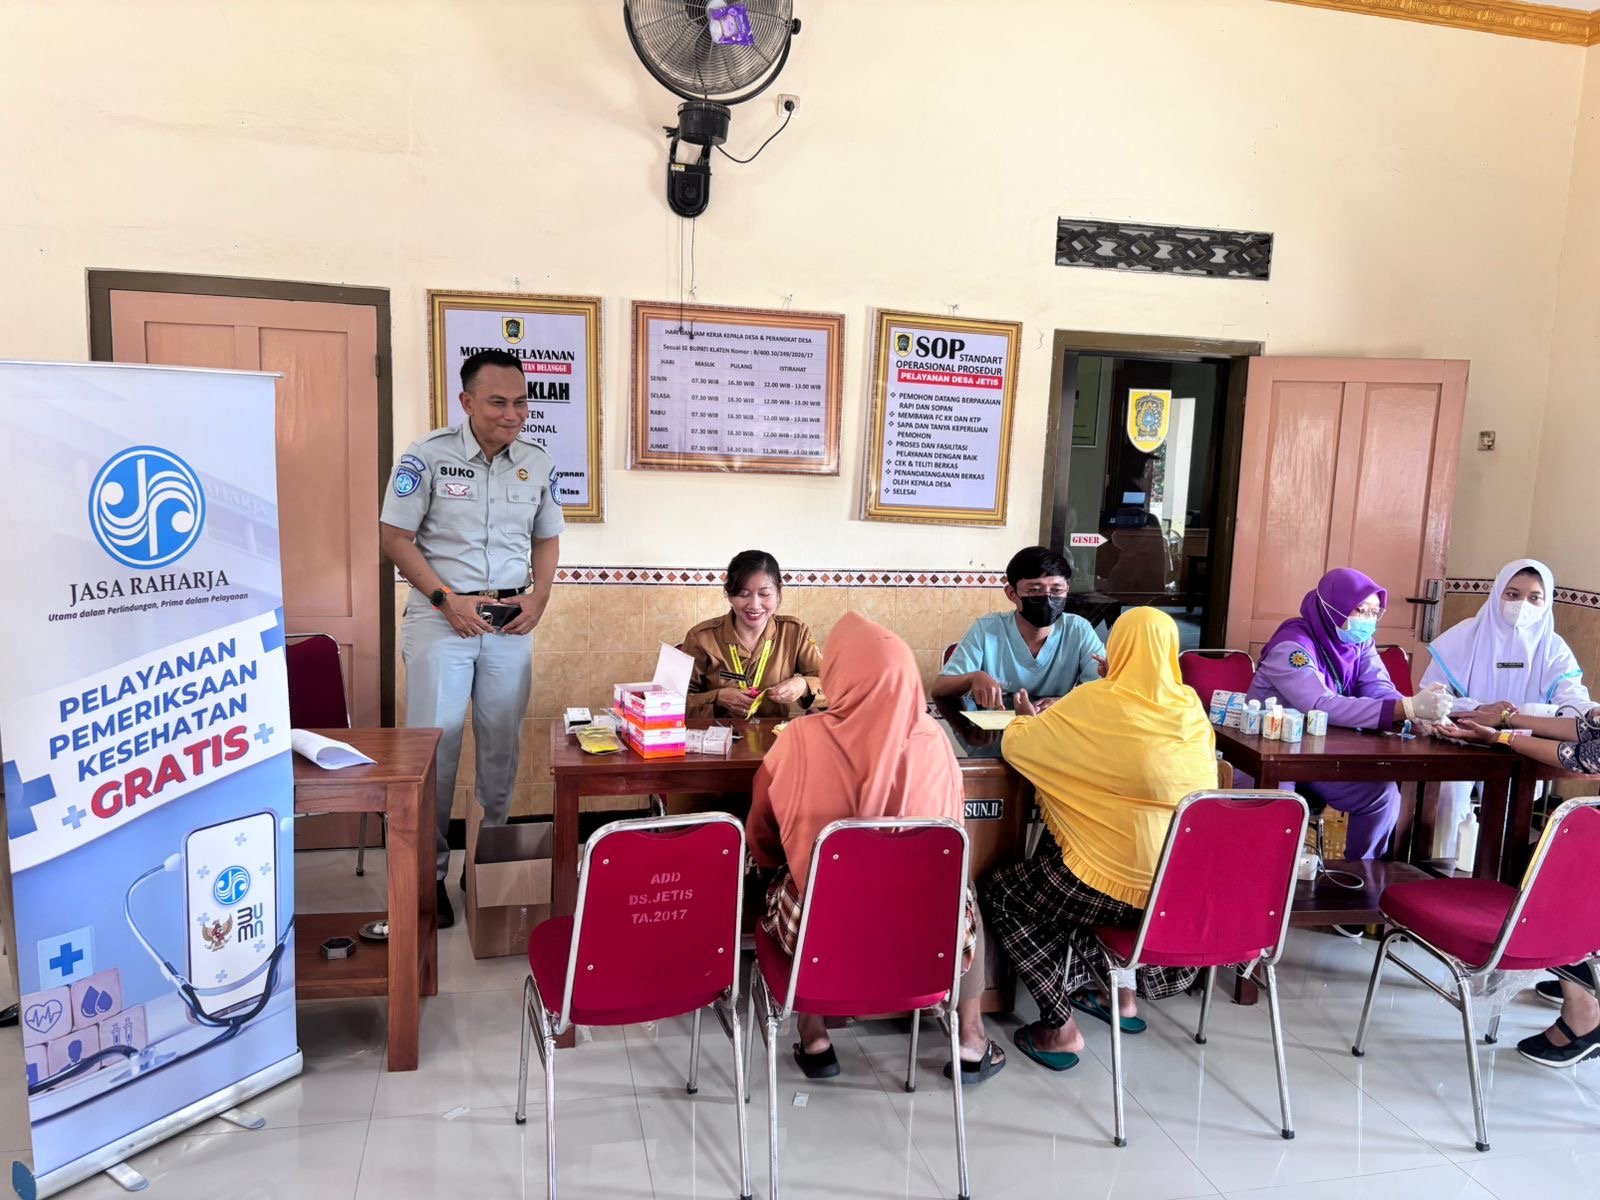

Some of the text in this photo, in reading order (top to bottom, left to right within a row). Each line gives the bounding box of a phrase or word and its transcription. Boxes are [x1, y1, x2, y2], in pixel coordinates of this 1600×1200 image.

[507, 348, 575, 361] PELAYANAN
[916, 336, 1003, 364] SOP STANDART
[896, 360, 1002, 376] OPERASIONAL PROSEDUR
[901, 372, 950, 382] PELAYANAN
[952, 376, 974, 384] DESA
[528, 382, 570, 400] KLAH
[899, 393, 933, 402] PEMOHON
[962, 397, 1001, 406] BERPAKAIAN
[527, 410, 544, 419] TEN
[898, 412, 934, 420] MEMBAWA
[521, 424, 558, 433] SIONAL
[952, 424, 988, 433] KEPERLUAN
[897, 431, 932, 440] PEMOHON
[896, 440, 920, 448] PROSES
[936, 442, 968, 450] FASILITASI
[896, 450, 933, 458] PELAYANAN
[440, 466, 474, 478] SUKO
[558, 472, 584, 480] yanan
[894, 470, 985, 480] PENANDATANGANAN BERKAS
[70, 570, 230, 607] JASA RAHARJA
[48, 592, 248, 622] Utama dalam Perlindungan, Prima dalam Pelayanan
[59, 638, 236, 723] PELAYANAN
[50, 660, 257, 760] PEMERIKSAAN
[78, 693, 248, 782] KESEHATAN
[91, 725, 250, 819] GRATIS
[964, 802, 999, 817] SUN.II
[650, 872, 681, 884] ADD
[629, 888, 694, 906] DS.JETIS
[632, 909, 688, 924] TA.2017
